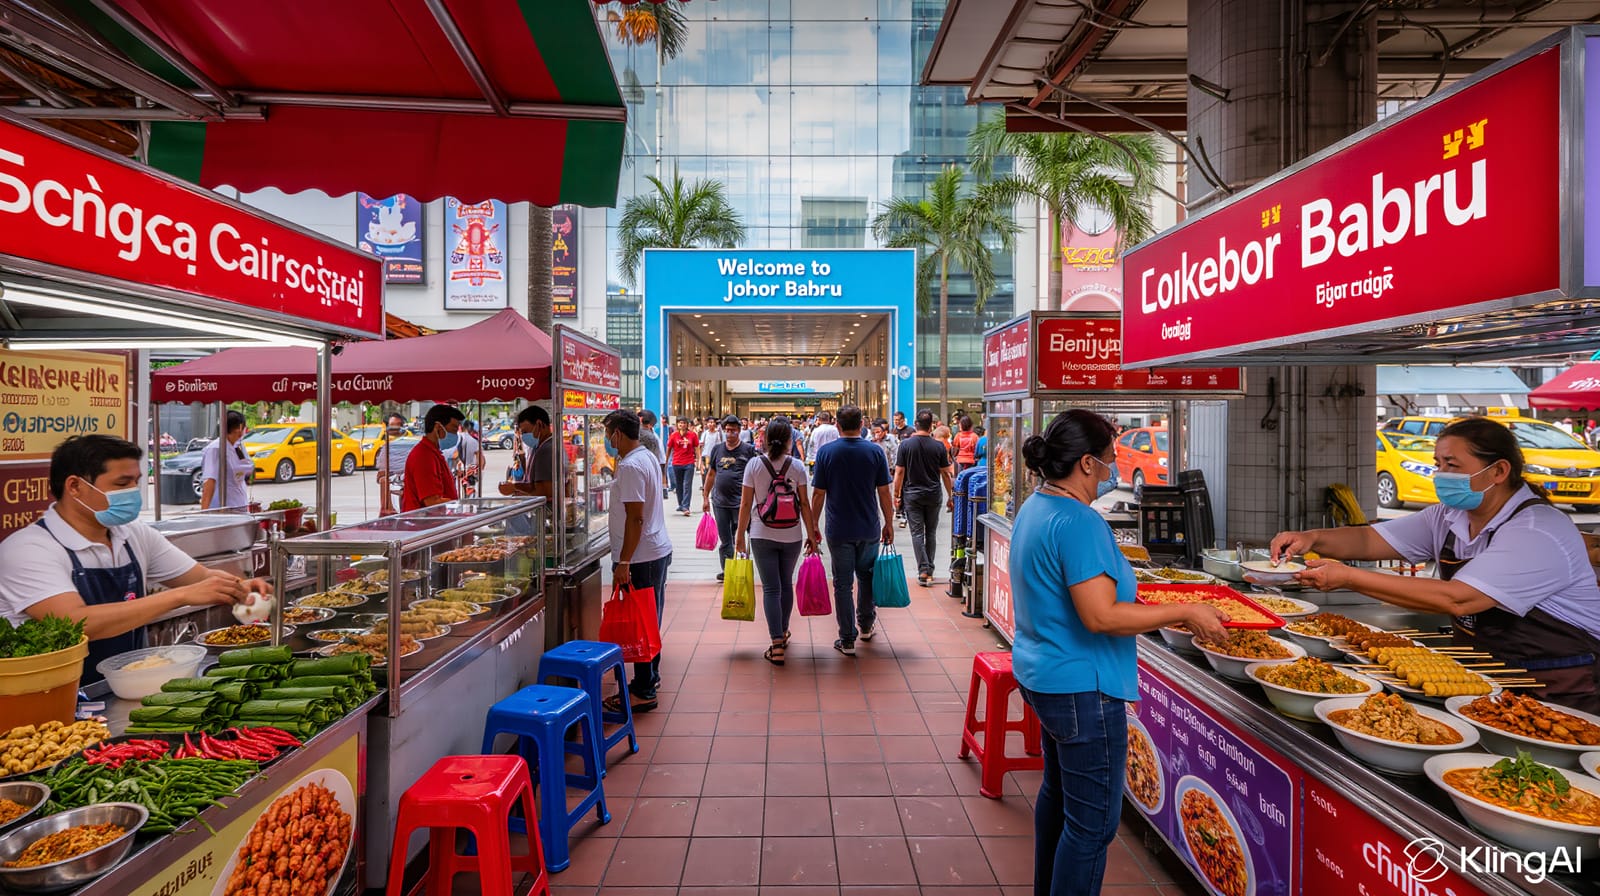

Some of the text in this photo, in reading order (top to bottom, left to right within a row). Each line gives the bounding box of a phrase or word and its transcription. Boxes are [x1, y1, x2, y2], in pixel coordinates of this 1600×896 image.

[717, 258, 831, 276] Welcome to
[723, 280, 780, 302] Johor
